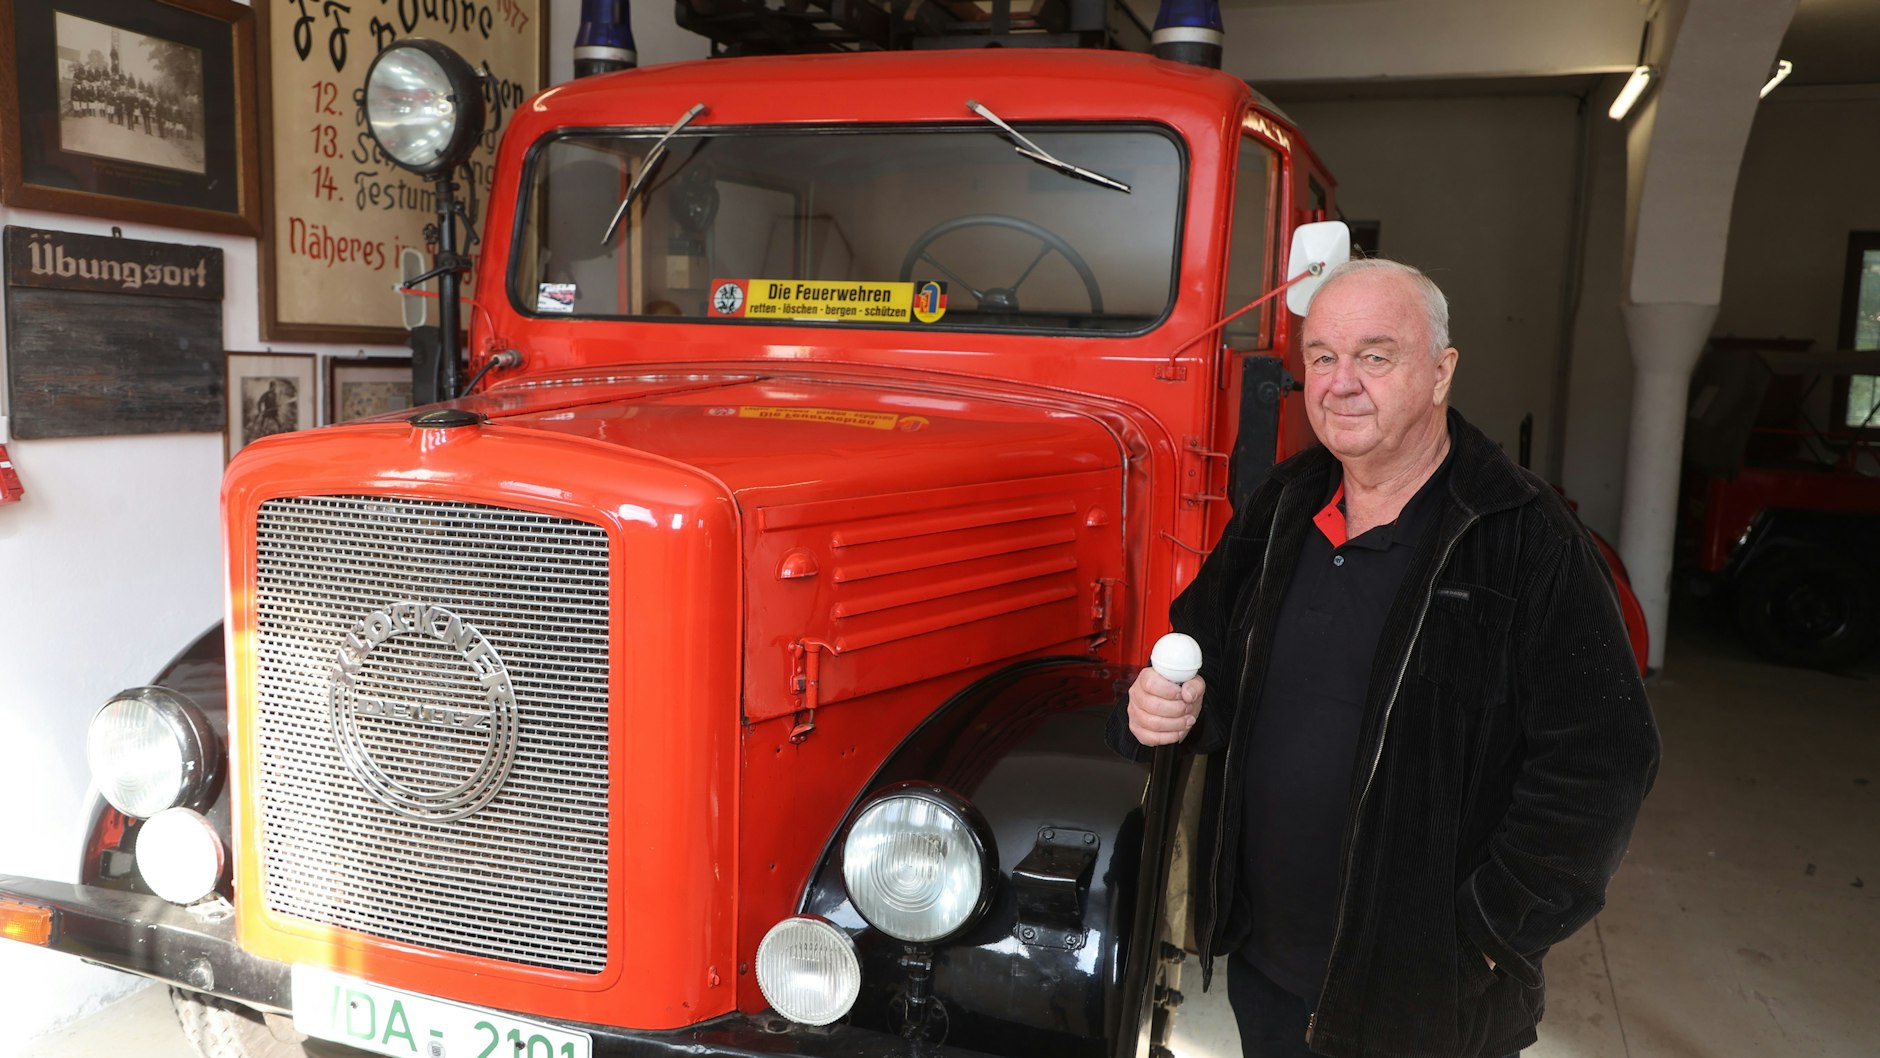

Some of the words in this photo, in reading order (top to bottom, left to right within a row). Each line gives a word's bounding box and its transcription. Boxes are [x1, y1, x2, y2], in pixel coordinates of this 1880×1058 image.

[312, 81, 343, 116] 12.
[310, 124, 344, 158] 13.
[312, 165, 343, 201] 14.
[289, 216, 385, 270] Näheres
[28, 233, 206, 289] Übungsort
[750, 304, 776, 314] retten
[783, 303, 818, 315] löschen
[825, 304, 857, 317] bergen
[864, 305, 906, 318] schützen
[768, 283, 790, 300] Die
[795, 284, 891, 303] Feuerwehren
[356, 697, 490, 733] DEUTZ
